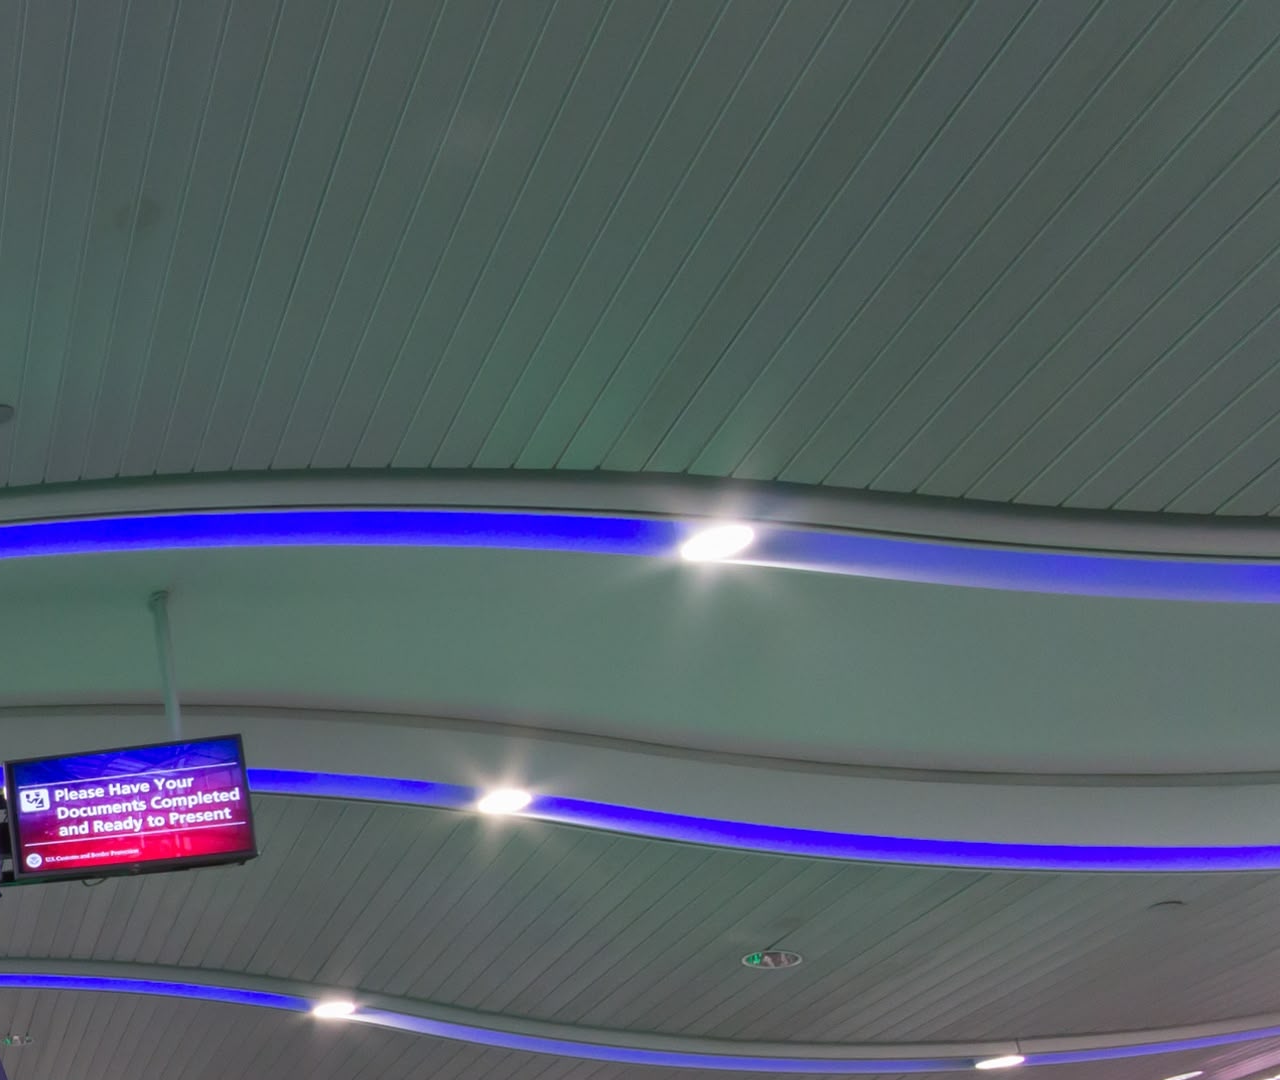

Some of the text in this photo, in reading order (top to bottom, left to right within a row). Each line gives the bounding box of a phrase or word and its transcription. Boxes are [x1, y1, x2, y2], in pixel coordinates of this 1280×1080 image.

[54, 776, 195, 802] Please Have Your
[57, 787, 241, 820] Documents Completed
[59, 807, 233, 837] and Ready to Present
